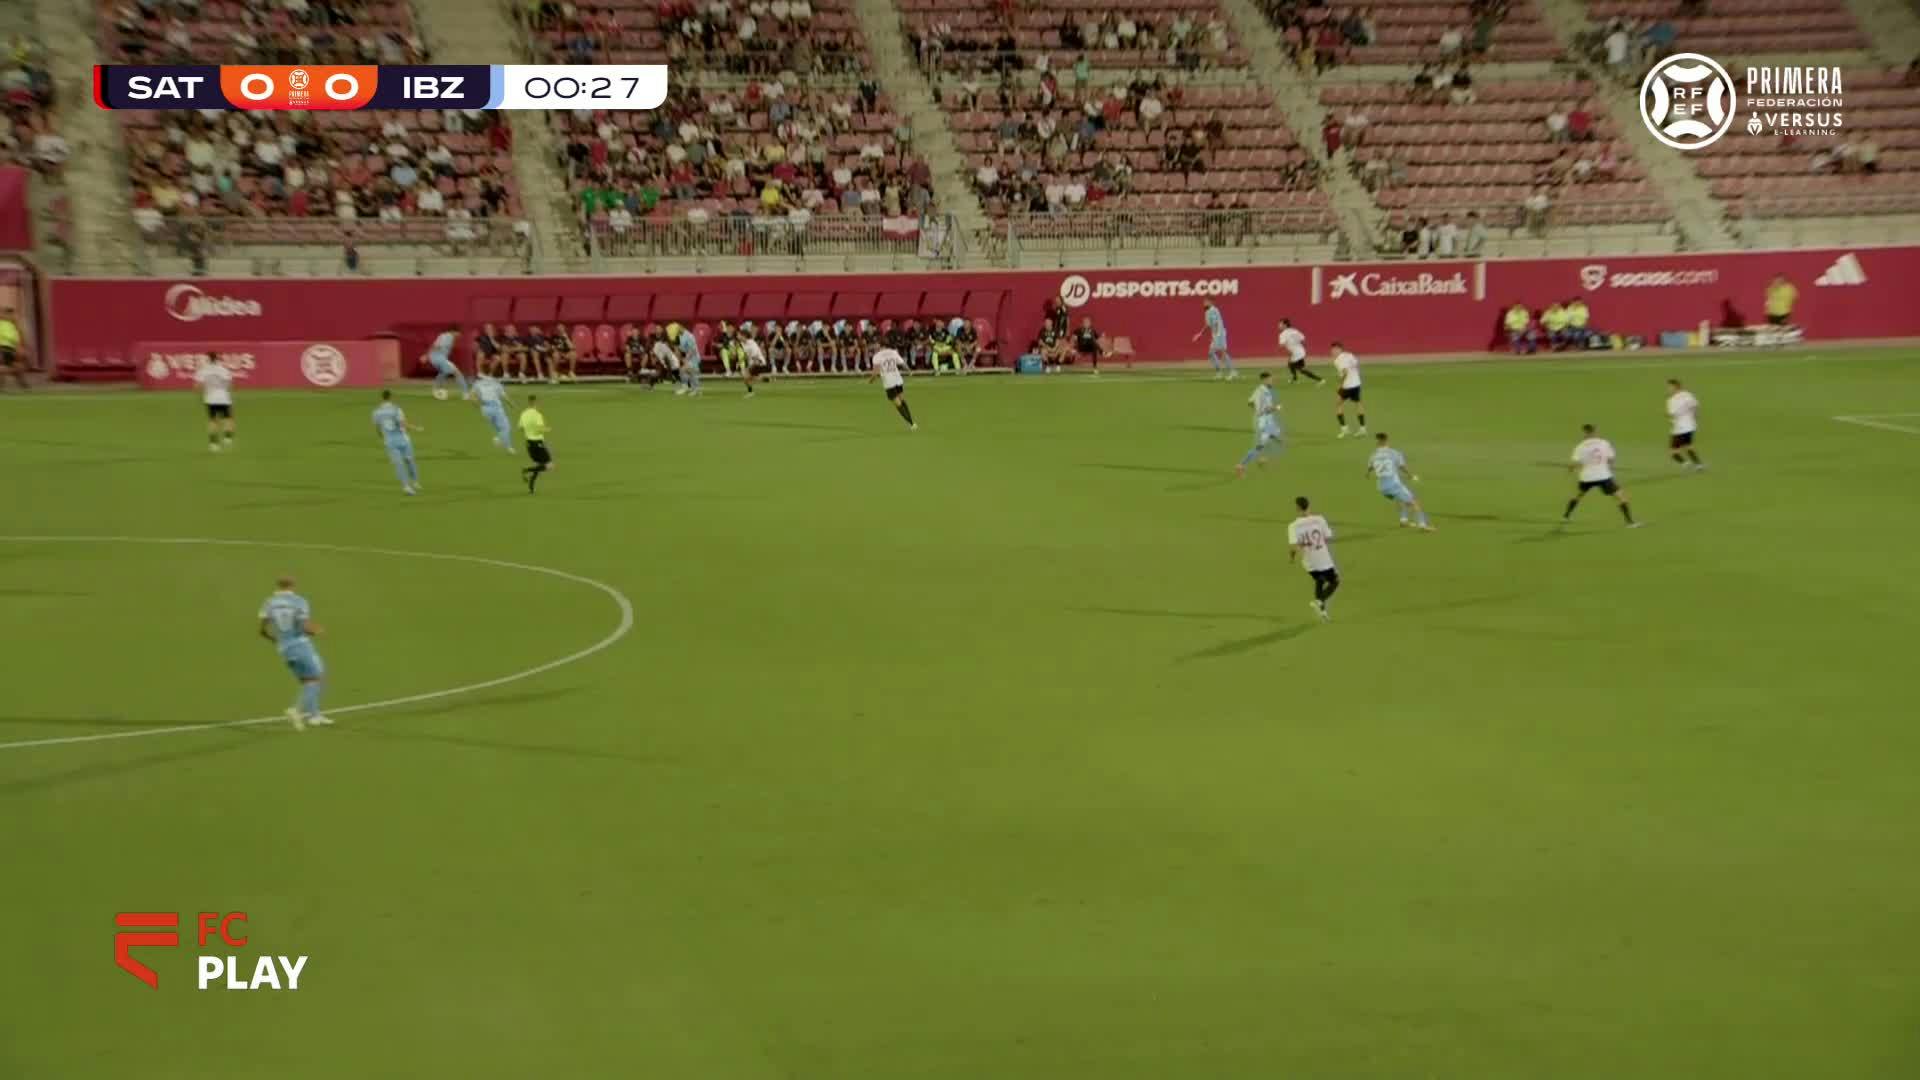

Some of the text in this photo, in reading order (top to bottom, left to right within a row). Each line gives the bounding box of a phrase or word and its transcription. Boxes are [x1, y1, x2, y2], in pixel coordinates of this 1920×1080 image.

[1065, 286, 1087, 300] JD
[1091, 278, 1239, 298] JDSPORTS.COM
[1361, 272, 1468, 297] CaixaBank
[184, 295, 263, 317] Midea
[165, 353, 256, 370] VERUS
[1298, 527, 1323, 550] 42
